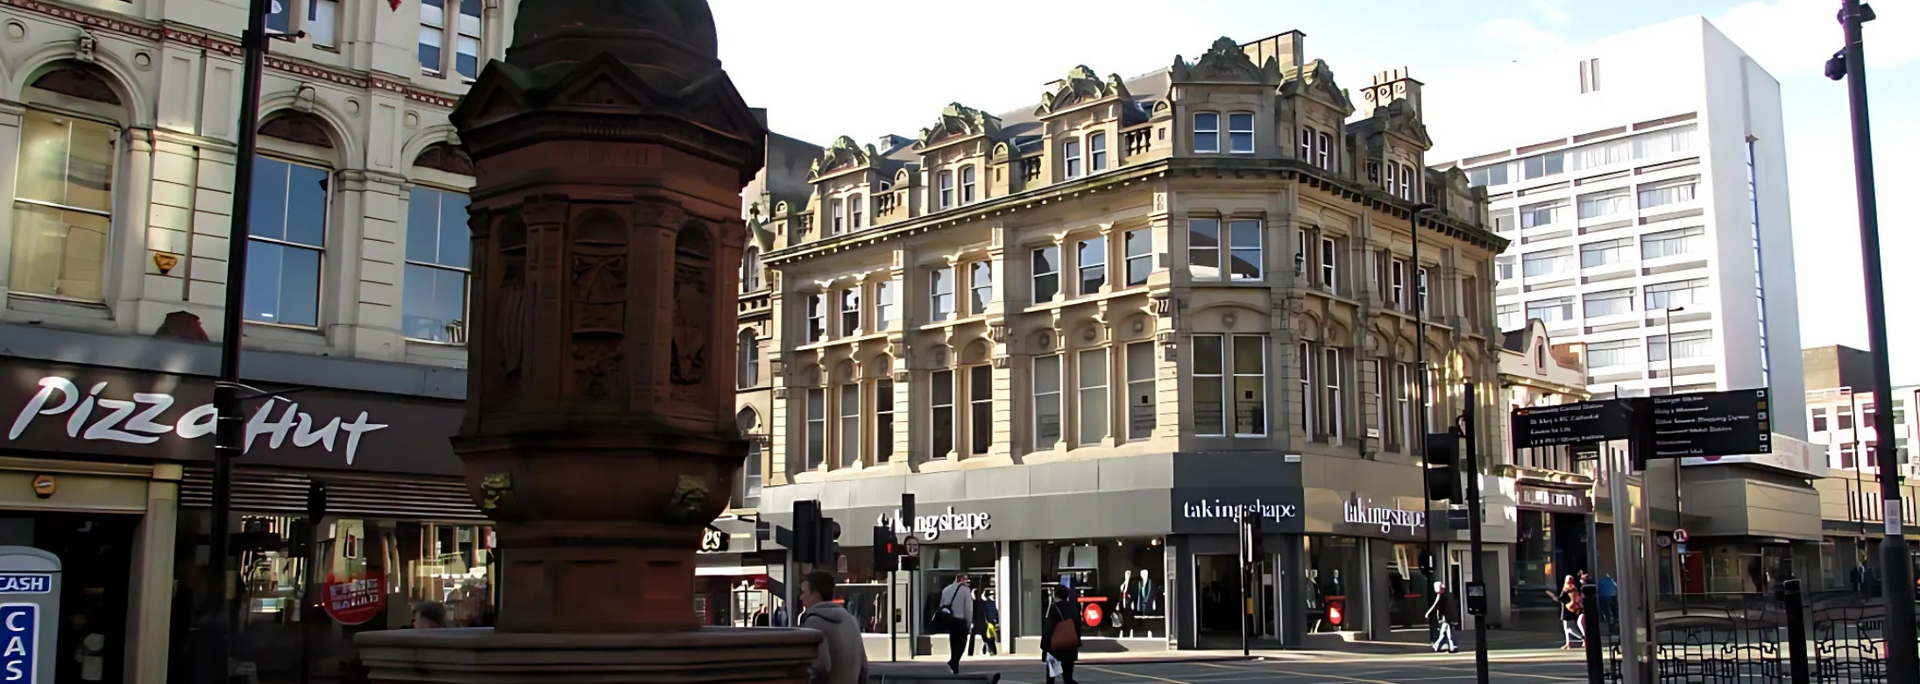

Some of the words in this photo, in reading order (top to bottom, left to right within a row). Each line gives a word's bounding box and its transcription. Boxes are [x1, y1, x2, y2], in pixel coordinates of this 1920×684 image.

[9, 376, 218, 444] Pizza
[243, 398, 389, 465] Hut
[876, 505, 989, 541] tkngshape
